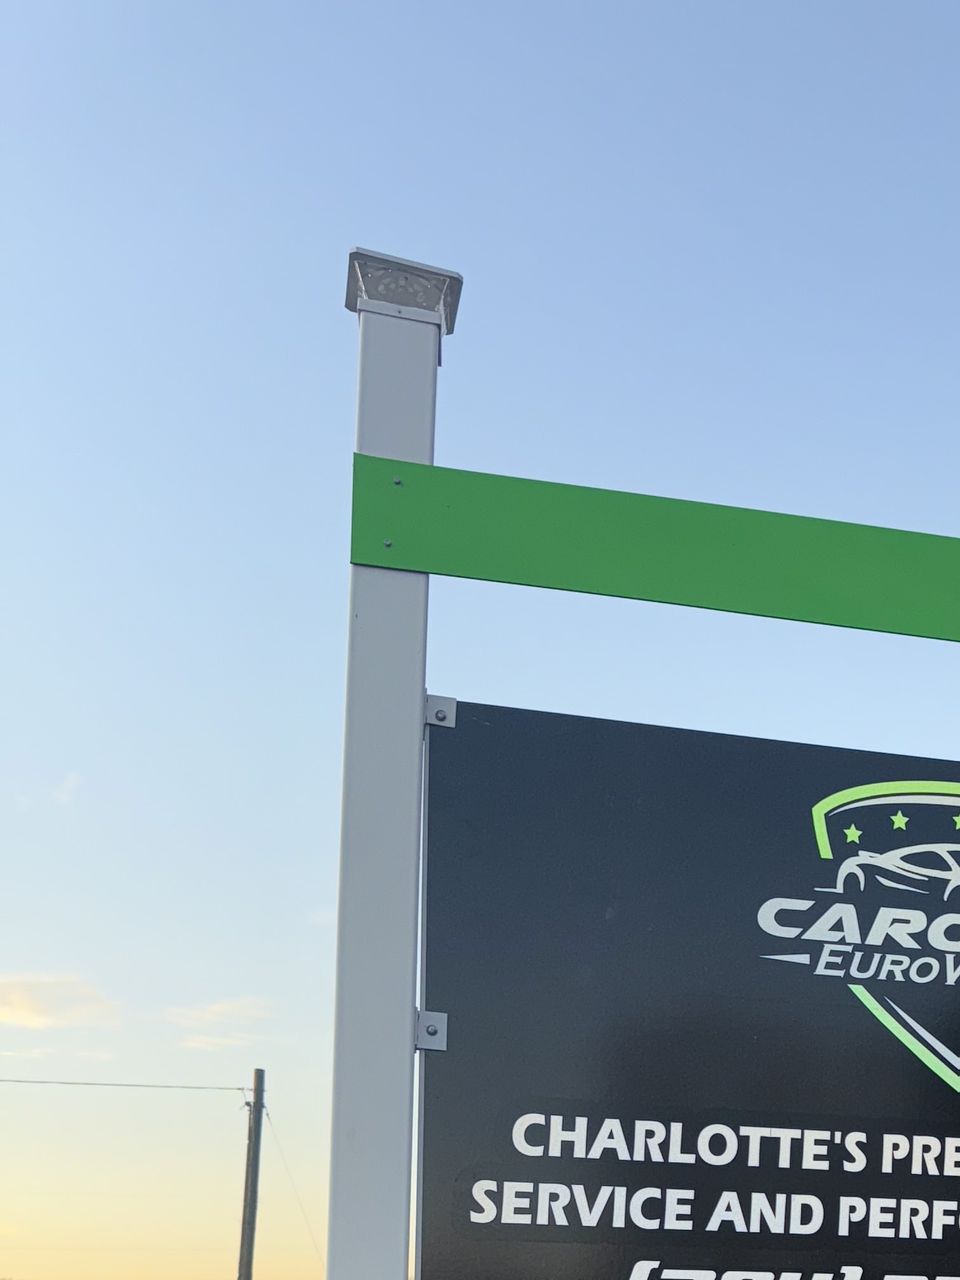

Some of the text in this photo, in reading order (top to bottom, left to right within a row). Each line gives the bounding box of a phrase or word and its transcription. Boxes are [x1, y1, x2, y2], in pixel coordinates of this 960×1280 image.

[511, 1112, 867, 1174] CHARLOTTE'S
[469, 1179, 695, 1231] SERVICE
[705, 1190, 824, 1235] AND
